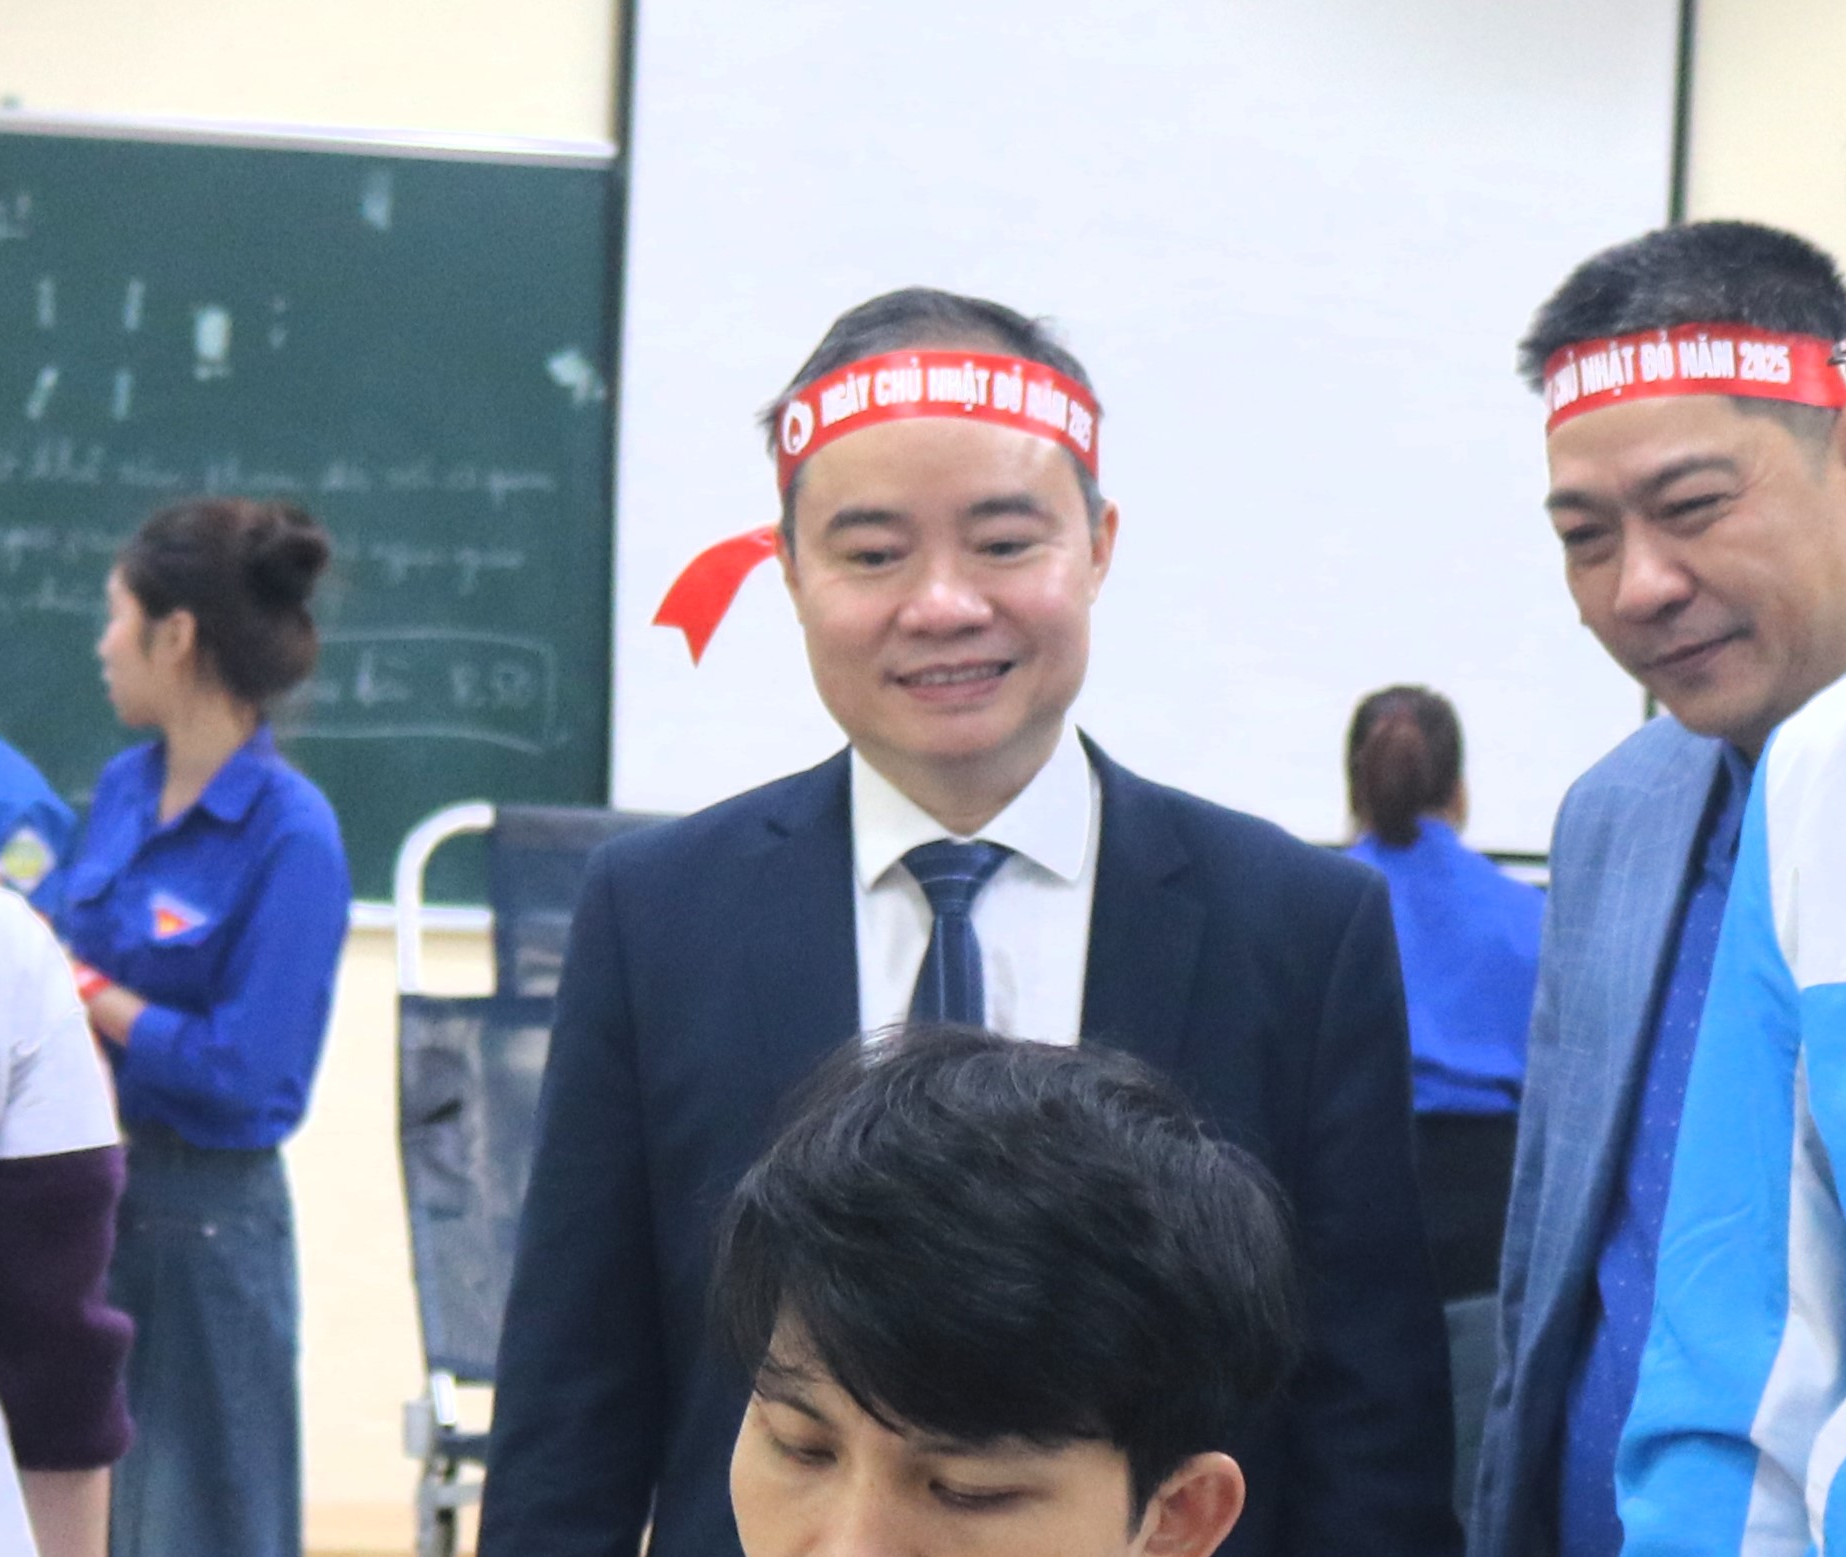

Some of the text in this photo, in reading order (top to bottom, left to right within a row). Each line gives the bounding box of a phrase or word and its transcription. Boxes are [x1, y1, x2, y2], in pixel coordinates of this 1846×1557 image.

[874, 357, 922, 406] CHỦ
[927, 362, 990, 411] NHẬT
[993, 364, 1023, 413] ĐỎ
[1025, 380, 1068, 430] NĂM
[1580, 342, 1635, 397] NHẬT
[1640, 330, 1675, 382] ĐỎ
[1678, 333, 1736, 379] NĂM
[1739, 341, 1791, 384] 2025
